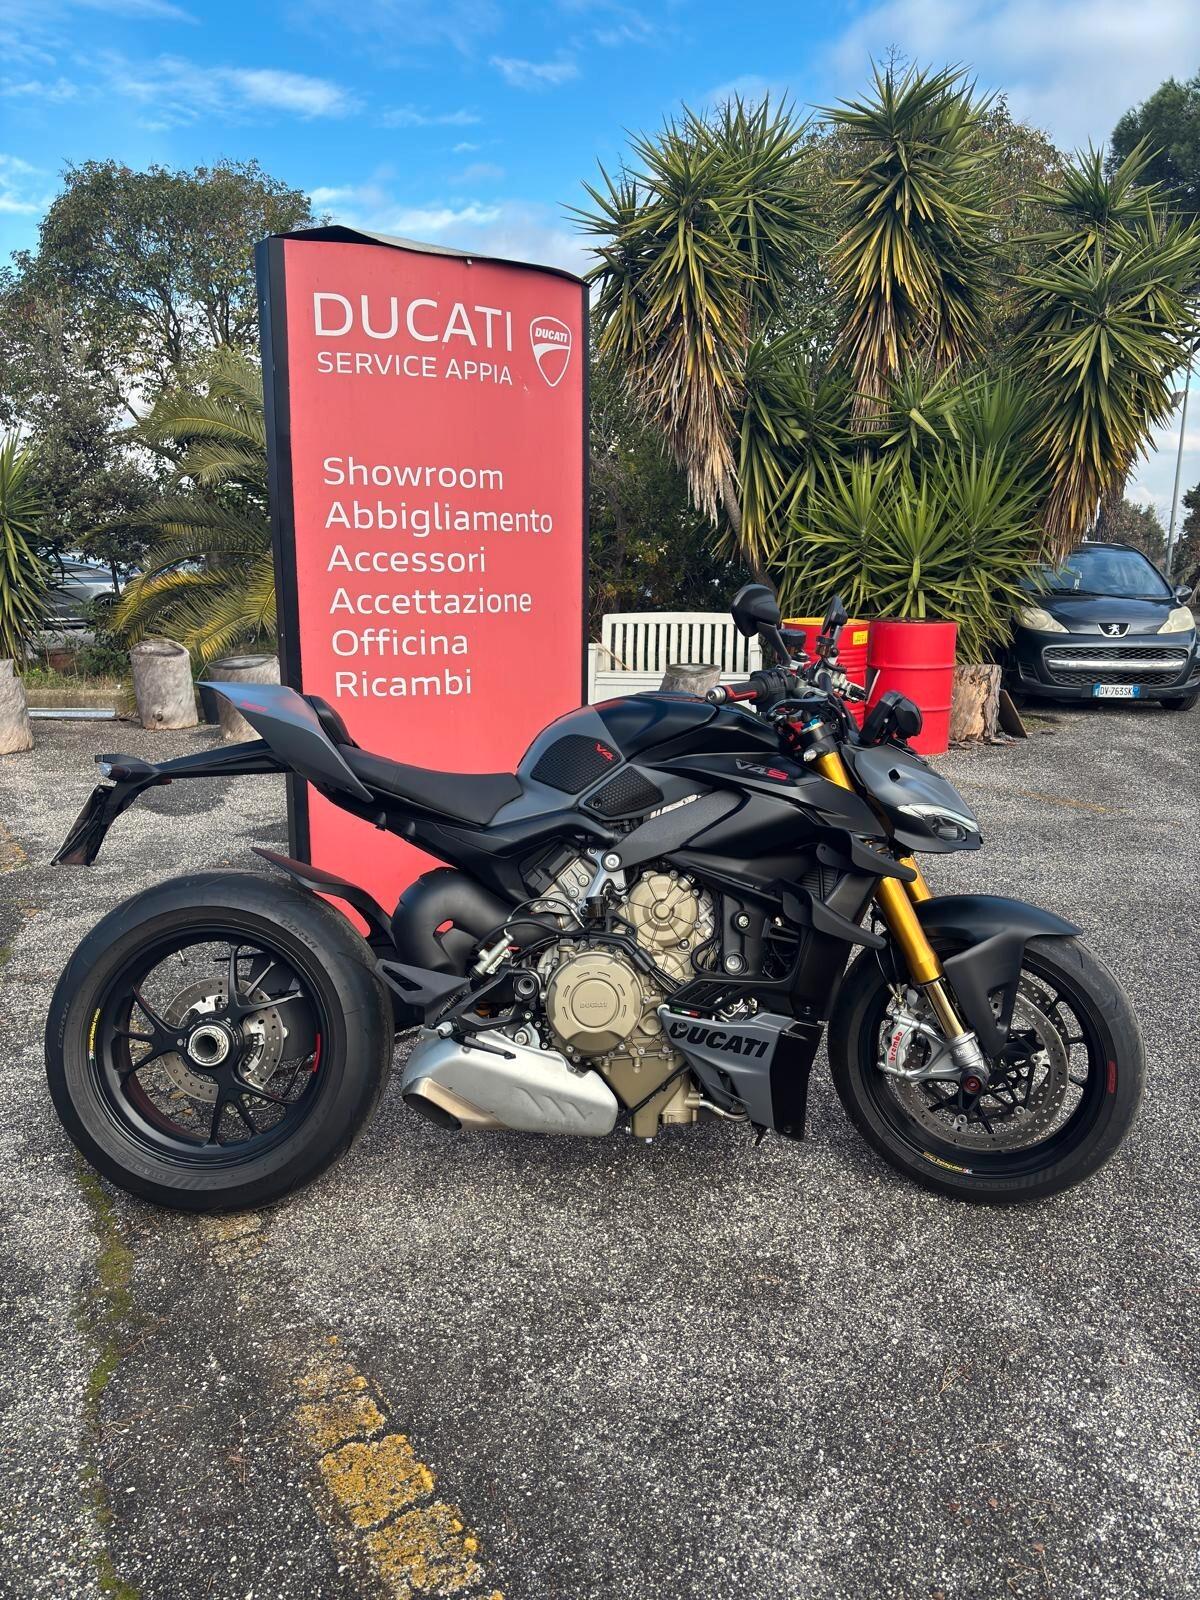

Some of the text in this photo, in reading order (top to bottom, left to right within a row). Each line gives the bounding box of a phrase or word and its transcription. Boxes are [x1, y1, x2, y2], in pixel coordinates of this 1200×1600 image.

[313, 292, 513, 352] DUCATI
[534, 327, 568, 343] DUCATI
[317, 351, 513, 386] SERVICE APPIA
[323, 456, 503, 490] Showroom
[325, 500, 553, 538] Abbigliamento
[327, 544, 486, 573] Accessori
[329, 587, 532, 615] Accettazione
[331, 628, 468, 656] Officina
[335, 668, 472, 698] Ricambi
[595, 742, 615, 761] V4
[735, 758, 788, 781] V4S
[579, 1001, 608, 1009] DUCATI
[669, 1021, 770, 1058] DUCATI
[888, 1031, 903, 1062] brembo
